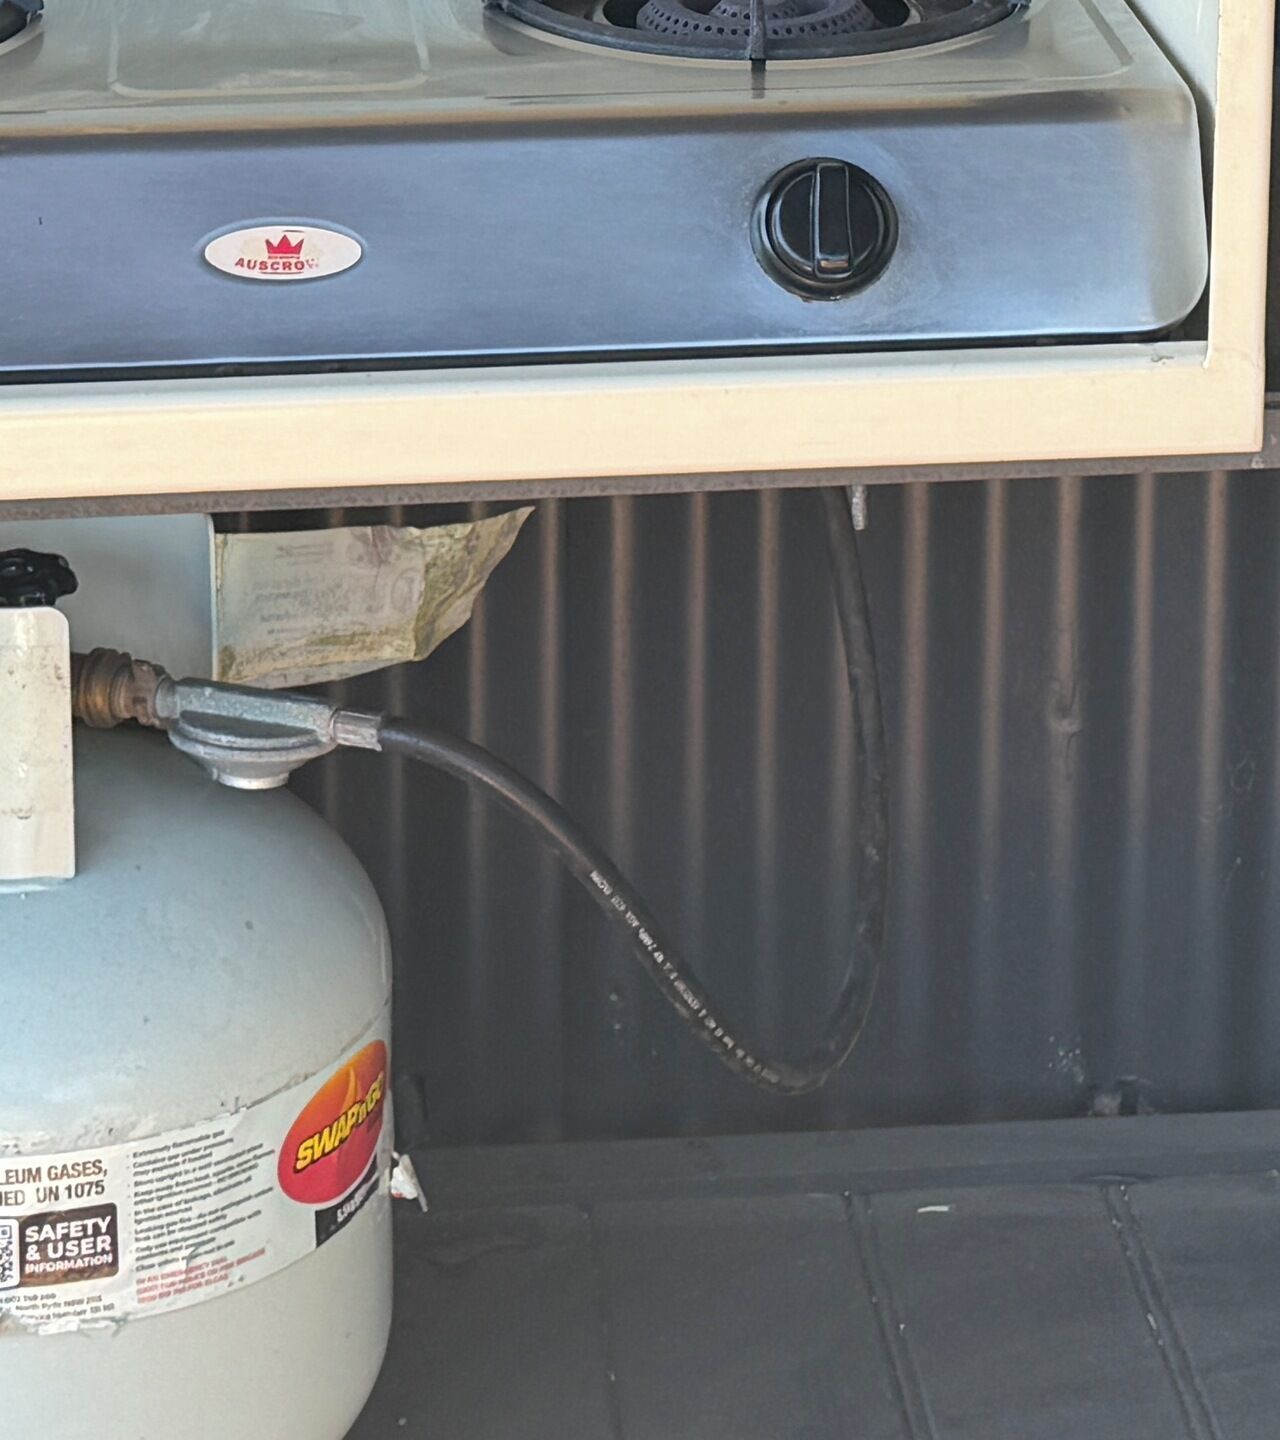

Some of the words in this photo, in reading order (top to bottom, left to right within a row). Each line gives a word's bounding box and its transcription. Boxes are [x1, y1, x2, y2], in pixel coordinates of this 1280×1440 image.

[235, 257, 319, 271] AUSCRO
[47, 1159, 108, 1181] GASES,
[36, 1186, 60, 1204] UN
[65, 1179, 105, 1200] 1075
[24, 1215, 112, 1243] SAFETY
[25, 1244, 41, 1261] &
[47, 1235, 112, 1259] USER
[24, 1253, 113, 1274] INFORMATION
